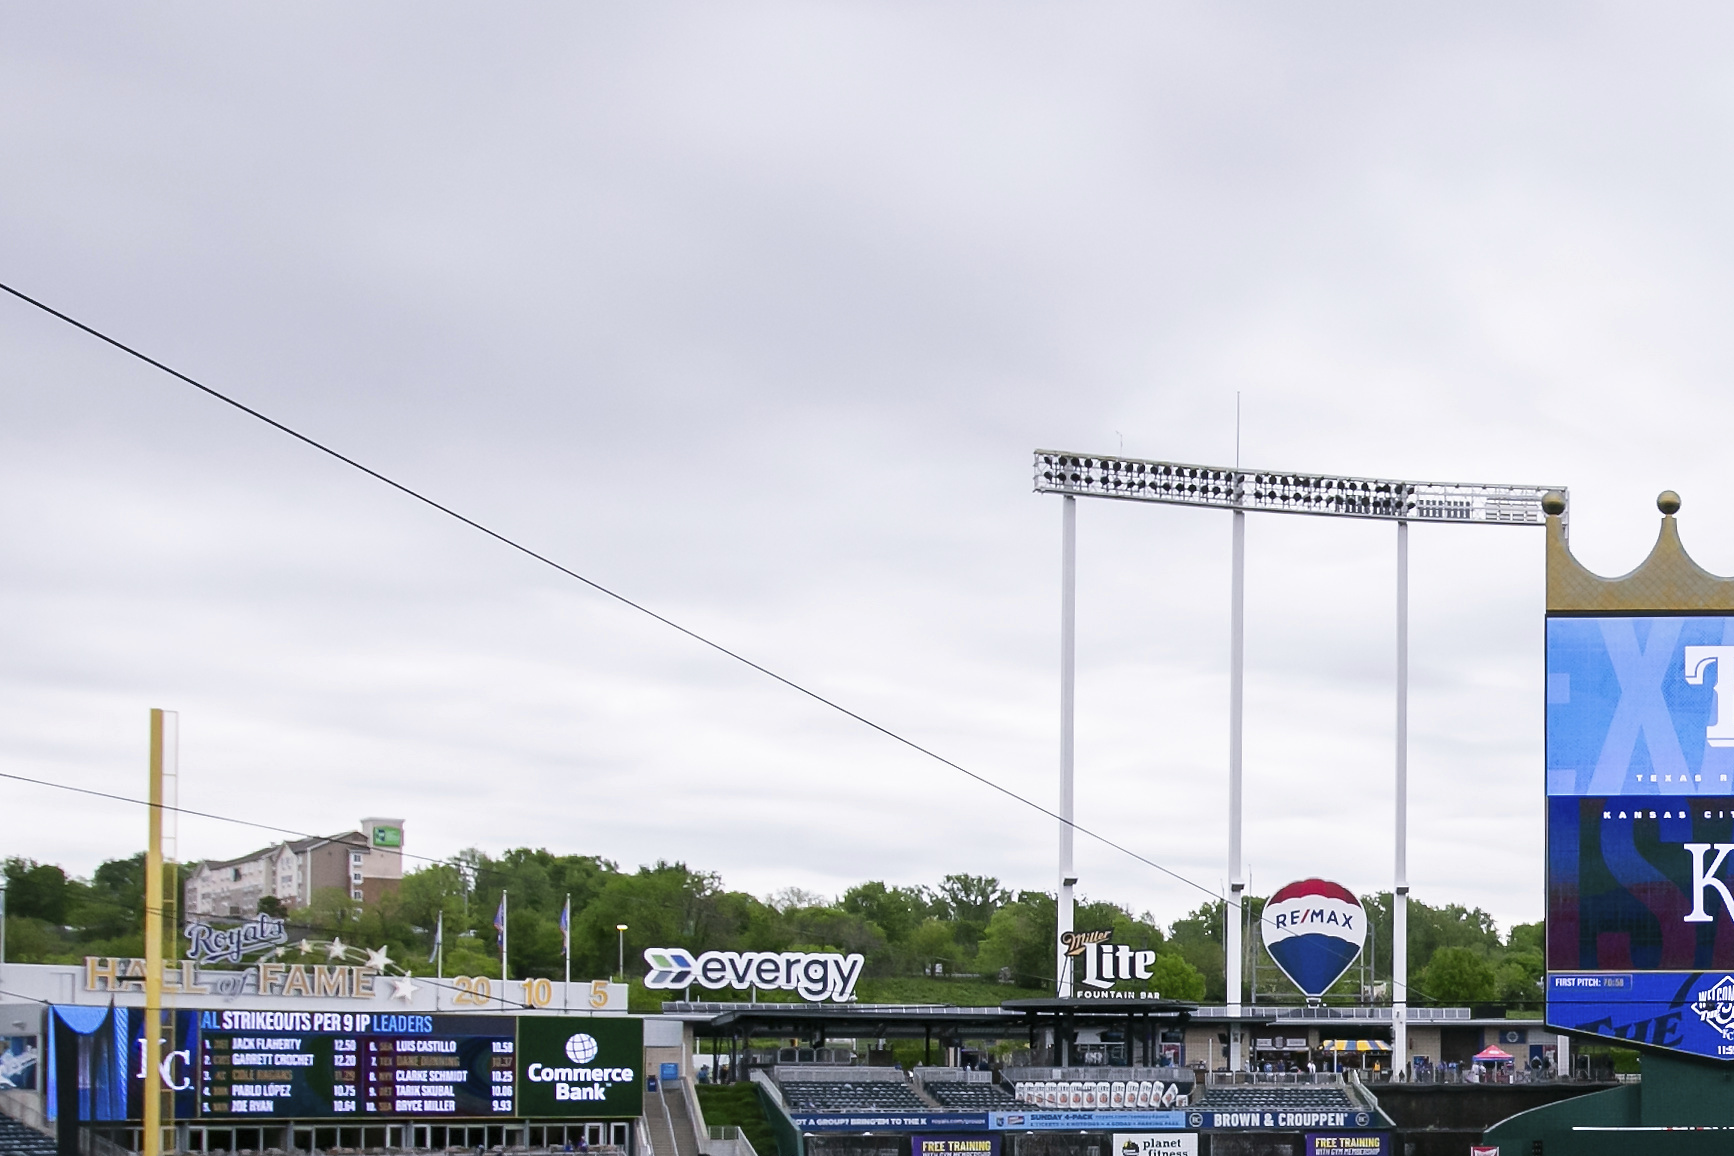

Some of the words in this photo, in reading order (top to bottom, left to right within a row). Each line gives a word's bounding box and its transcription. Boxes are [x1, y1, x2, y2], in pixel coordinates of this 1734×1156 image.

[1636, 773, 1702, 783] TEXAS
[1602, 810, 1687, 820] KANSAS
[1276, 909, 1353, 930] RE/MAX
[184, 913, 288, 965] Royals
[1062, 931, 1112, 953] Miller
[1082, 942, 1156, 989] Lite
[85, 956, 209, 994] HALL
[257, 963, 377, 998] FAME
[702, 958, 858, 997] evergy
[1556, 977, 1575, 987] FIRST
[1576, 977, 1602, 987] PITCH:
[452, 976, 492, 1006] 20
[520, 978, 552, 1008] 10
[590, 979, 610, 1008] 5
[1077, 991, 1135, 999] FOUNTAIN
[1140, 991, 1160, 1000] BAR
[201, 1011, 220, 1029] AL
[222, 1012, 311, 1032] STRIKEOUTS
[313, 1013, 341, 1031] PER
[343, 1014, 353, 1031] 9
[355, 1014, 371, 1032] IP
[373, 1014, 433, 1033] LEADERS
[232, 1038, 255, 1051] JACK
[256, 1038, 302, 1051] FLAHERTY
[334, 1038, 357, 1051] 12.50
[396, 1040, 416, 1053] LUIS
[417, 1040, 457, 1053] CASTILLO
[232, 1053, 273, 1066] GARRETT
[274, 1053, 314, 1066] CROCHET
[334, 1053, 357, 1066] 12.20
[395, 1070, 428, 1082] CLARKE
[429, 1070, 468, 1082] SCHMIDT
[492, 1070, 513, 1082] 10.25
[528, 1063, 634, 1083] Commerce
[232, 1084, 262, 1097] PABLO
[263, 1082, 292, 1097] LÓPEZ
[334, 1084, 356, 1097] 10.75
[395, 1085, 421, 1097] TARIK
[421, 1085, 455, 1097] SKUBAL
[555, 1083, 606, 1101] Bank
[231, 1100, 248, 1113] JOE
[249, 1100, 274, 1113] RYAN
[334, 1100, 356, 1113] 10.64
[395, 1100, 422, 1112] BRYCE
[423, 1100, 455, 1112] MILLER
[492, 1100, 512, 1112] 9.93
[808, 1118, 816, 1126] A
[816, 1118, 849, 1126] GROUP?
[890, 1118, 903, 1126] TO
[903, 1118, 919, 1126] THE
[920, 1118, 927, 1126] K
[1030, 1113, 1063, 1121] SUNDAY
[1064, 1113, 1094, 1121] 4-PACK
[1213, 1113, 1260, 1126] BROWN
[1263, 1113, 1275, 1127] &
[1278, 1113, 1346, 1126] CROUPPEN
[922, 1140, 945, 1152] FREE
[947, 1140, 991, 1152] TRAINING
[1143, 1138, 1181, 1152] planet
[1315, 1137, 1337, 1149] FREE
[1340, 1137, 1380, 1149] TRAINING
